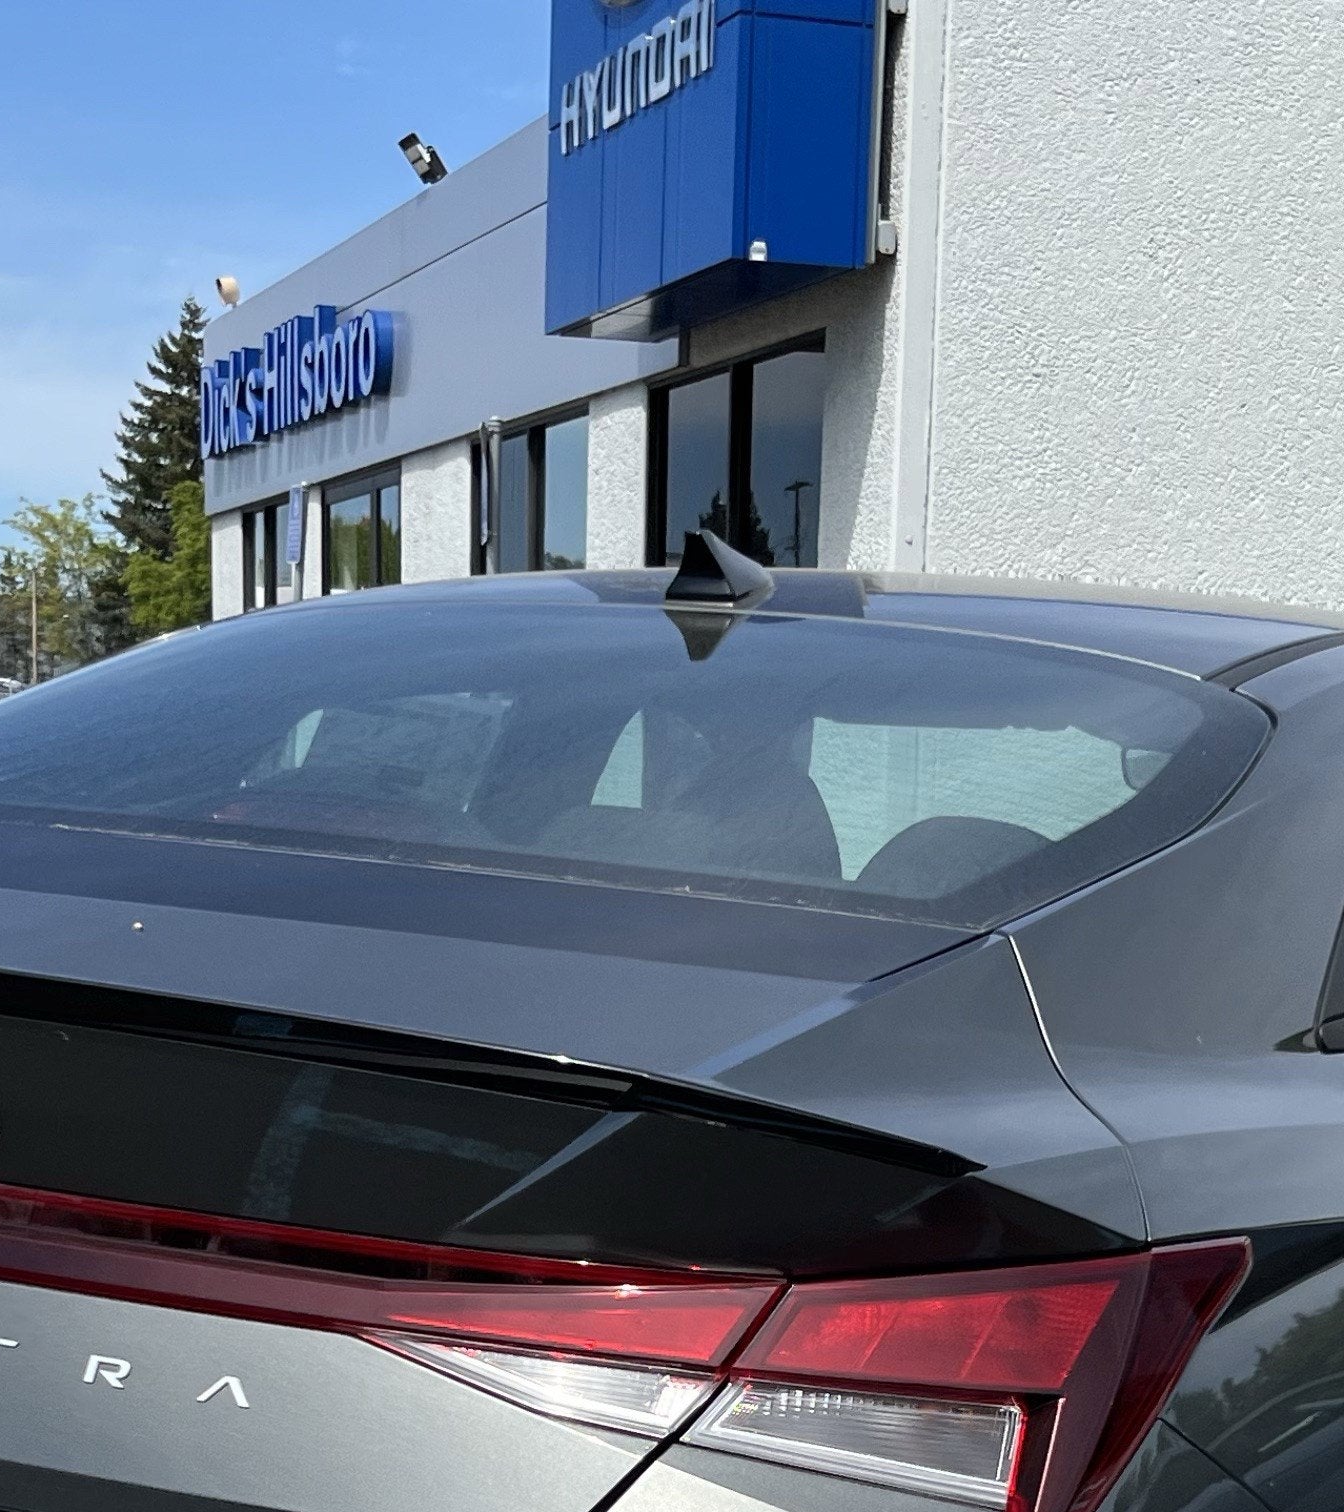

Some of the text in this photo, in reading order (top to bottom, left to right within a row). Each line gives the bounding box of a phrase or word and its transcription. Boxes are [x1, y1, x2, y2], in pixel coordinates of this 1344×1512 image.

[560, 0, 714, 157] HYUNDAI
[200, 303, 378, 460] Dick's Hillsboro
